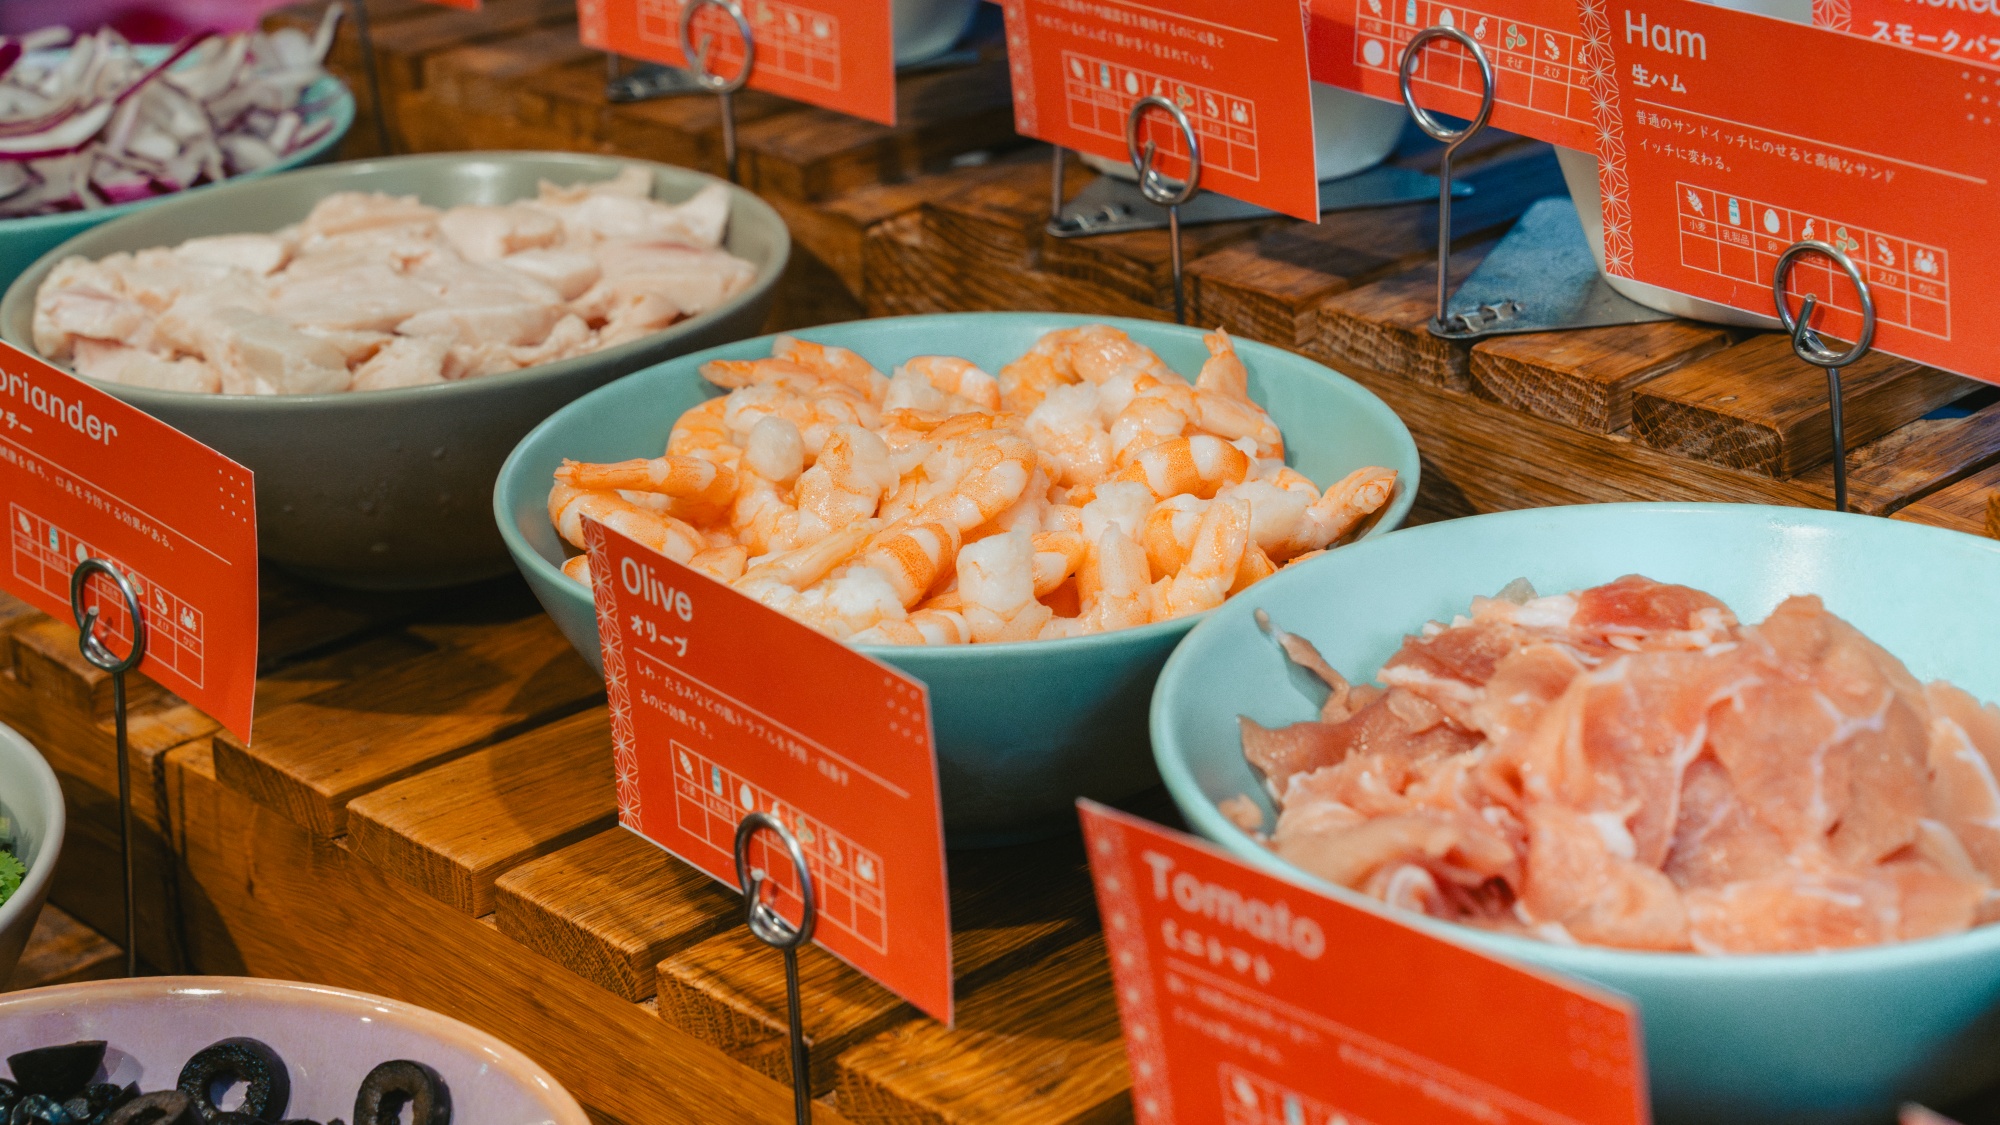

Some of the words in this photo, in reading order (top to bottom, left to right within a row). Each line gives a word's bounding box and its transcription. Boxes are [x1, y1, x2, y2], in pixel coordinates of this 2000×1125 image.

[1625, 10, 1706, 60] Ham
[1507, 56, 1522, 69] そば
[1544, 65, 1560, 79] えび
[1632, 64, 1687, 94] 生ハム
[1635, 109, 1896, 183] 普通のサンドイッチにのせると高級なサンド
[1639, 138, 1732, 172] イッチに変わる。
[1689, 219, 1707, 234] 小麦
[1722, 229, 1750, 246] 乳製品
[0, 407, 33, 434] チー
[621, 556, 693, 622] Olive
[1142, 851, 1326, 961] Tomato
